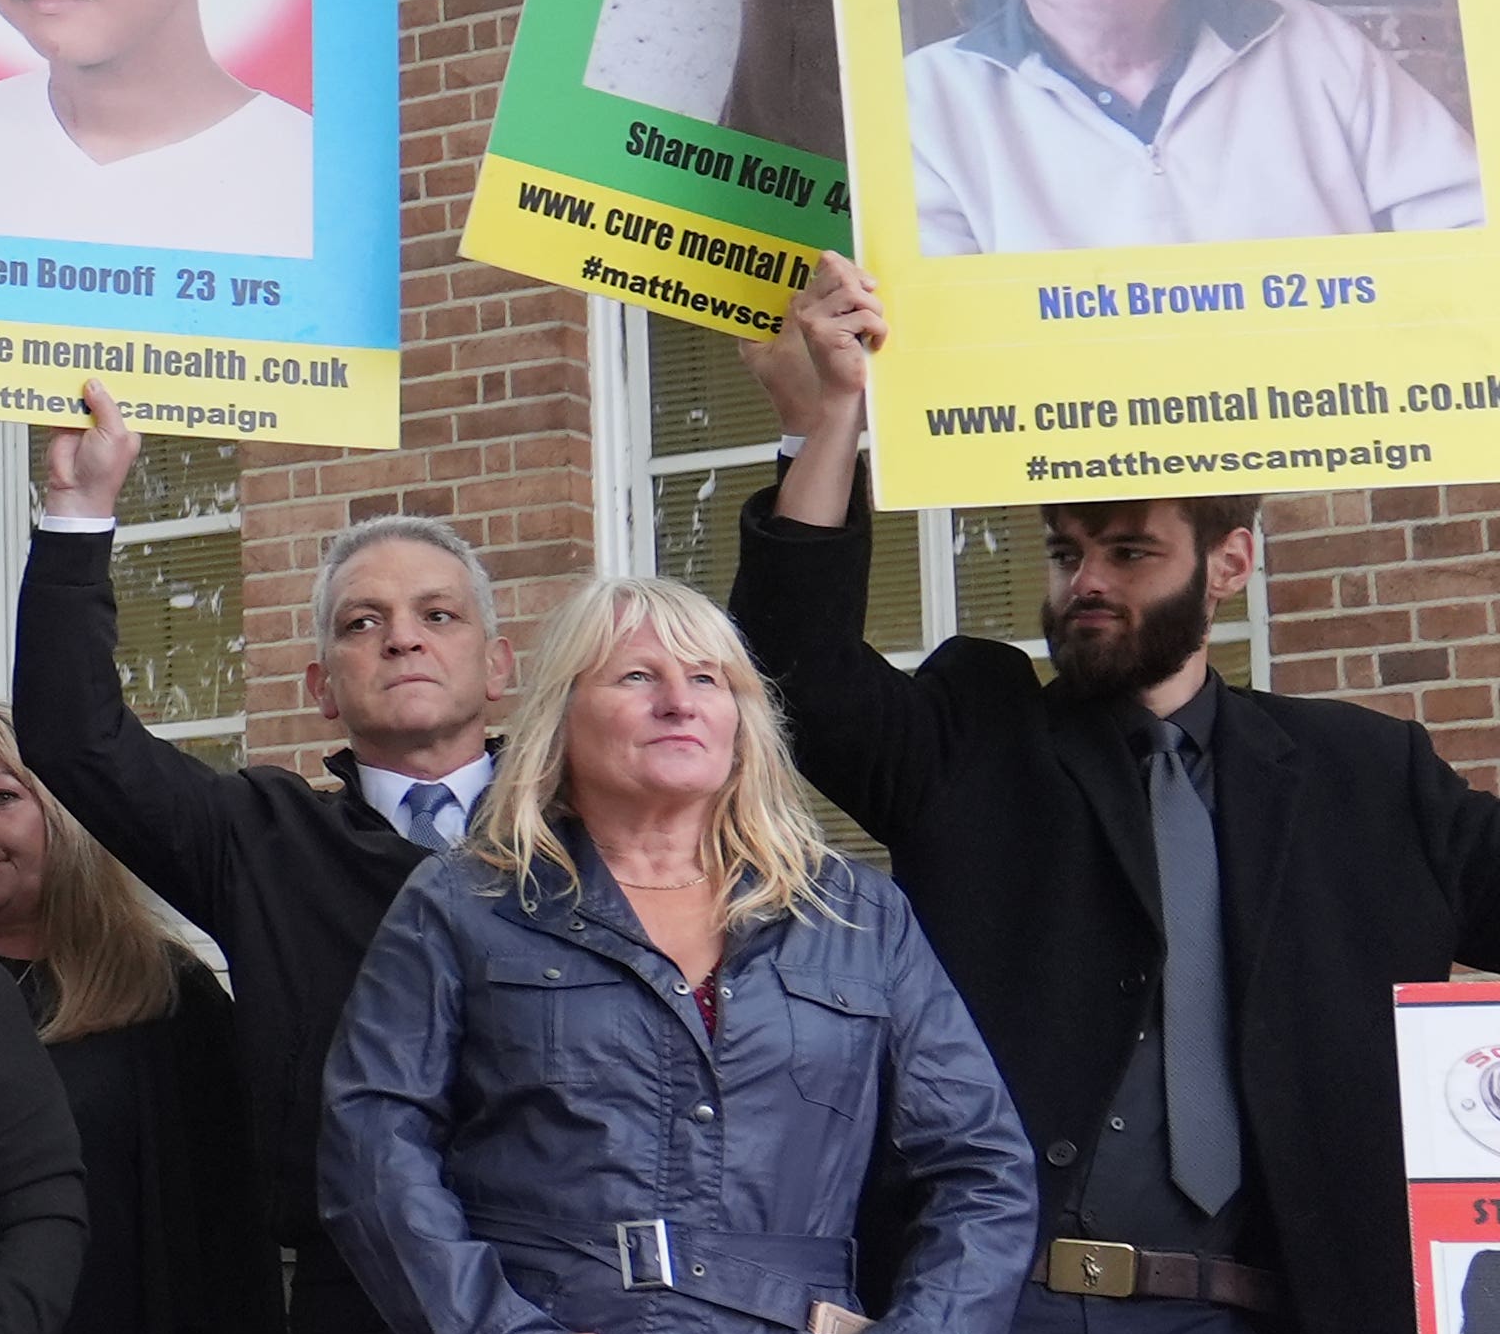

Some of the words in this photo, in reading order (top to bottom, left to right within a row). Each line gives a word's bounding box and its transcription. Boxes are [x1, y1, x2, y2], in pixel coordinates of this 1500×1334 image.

[625, 121, 734, 183] Sharon
[736, 153, 816, 208] Kelly
[37, 257, 156, 297] Booroff
[175, 268, 215, 301] 23
[230, 278, 281, 307] yrs
[1038, 283, 1119, 320] Nick
[1126, 282, 1244, 315] Brown
[1262, 273, 1308, 309] 62
[1315, 275, 1375, 309] yrs
